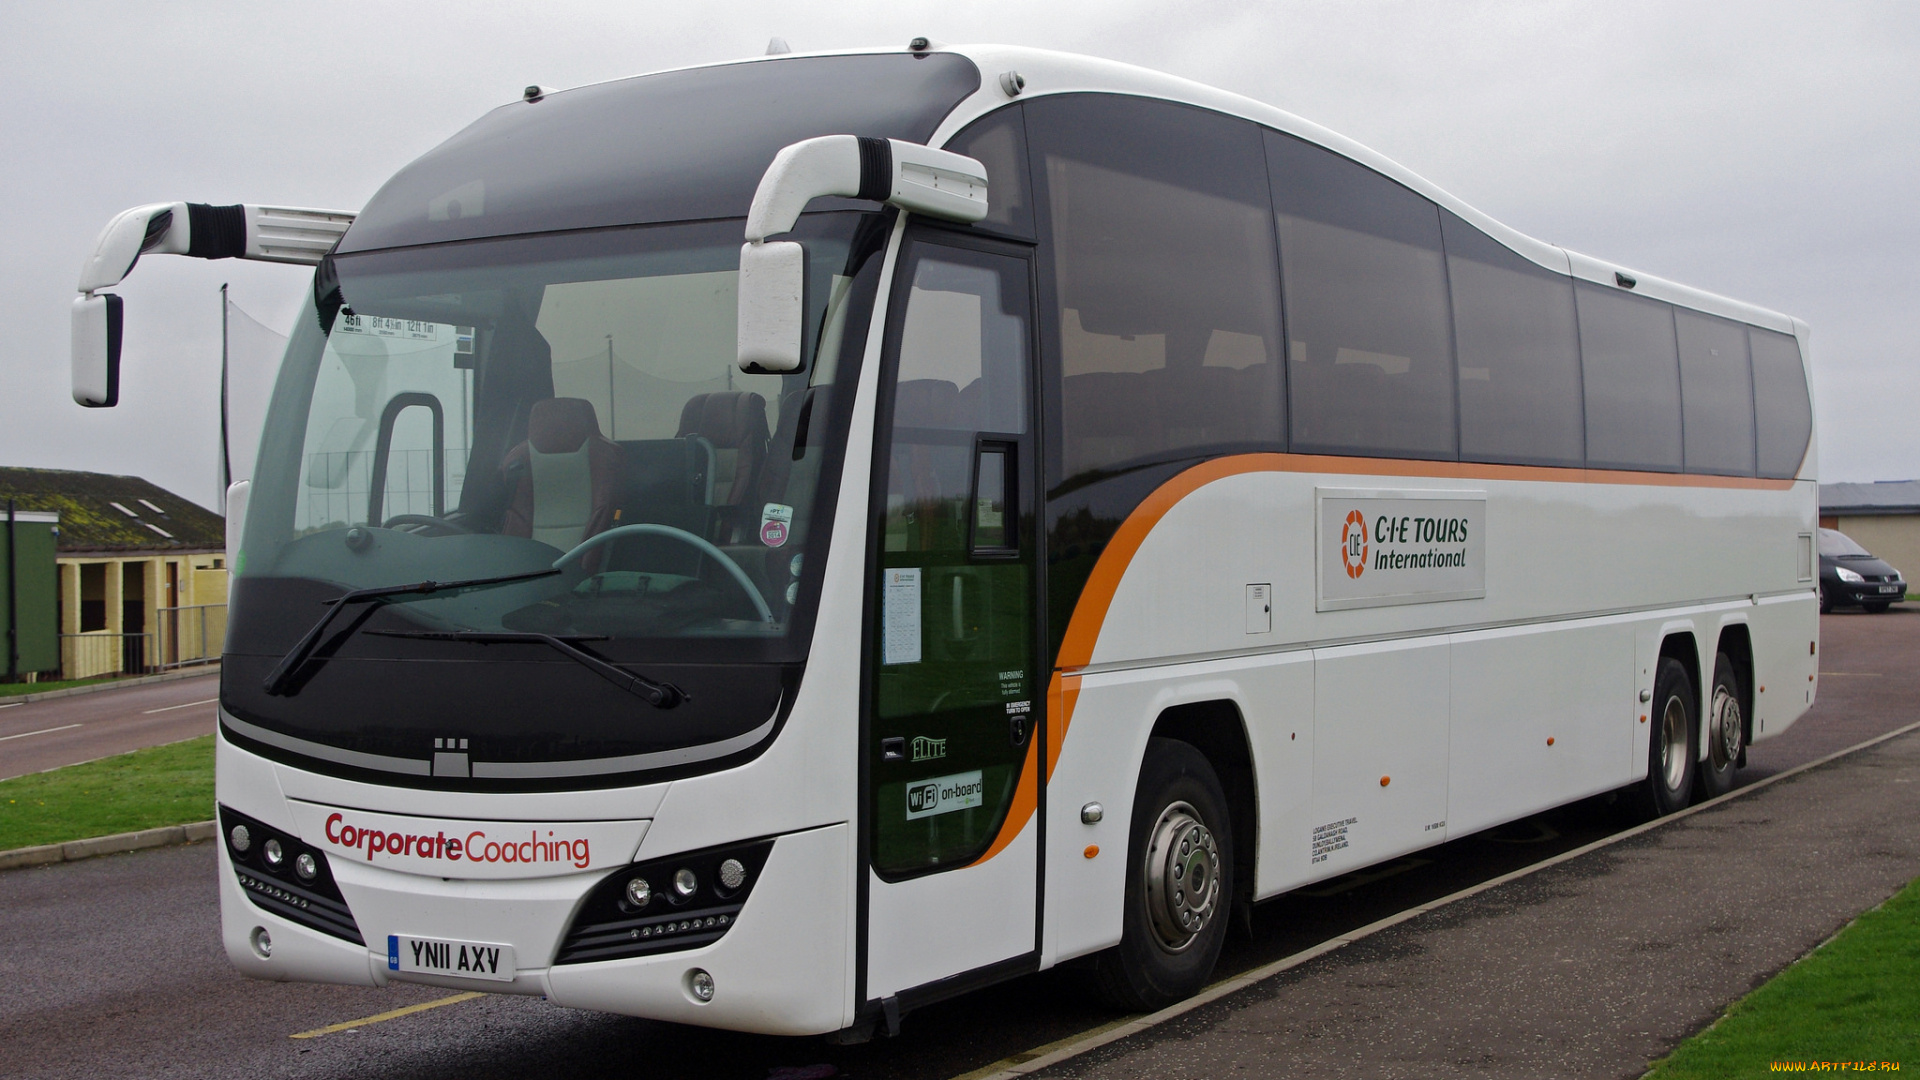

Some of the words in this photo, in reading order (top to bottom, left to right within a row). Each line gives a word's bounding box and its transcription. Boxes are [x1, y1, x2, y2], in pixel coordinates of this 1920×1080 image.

[1413, 517, 1468, 544] TOURS
[1374, 548, 1466, 570] International
[998, 670, 1024, 681] WARNING
[912, 738, 947, 761] ELITE
[941, 778, 982, 801] on-board
[389, 956, 398, 964] GB
[410, 940, 450, 969] YN11
[457, 945, 500, 974] AXV
